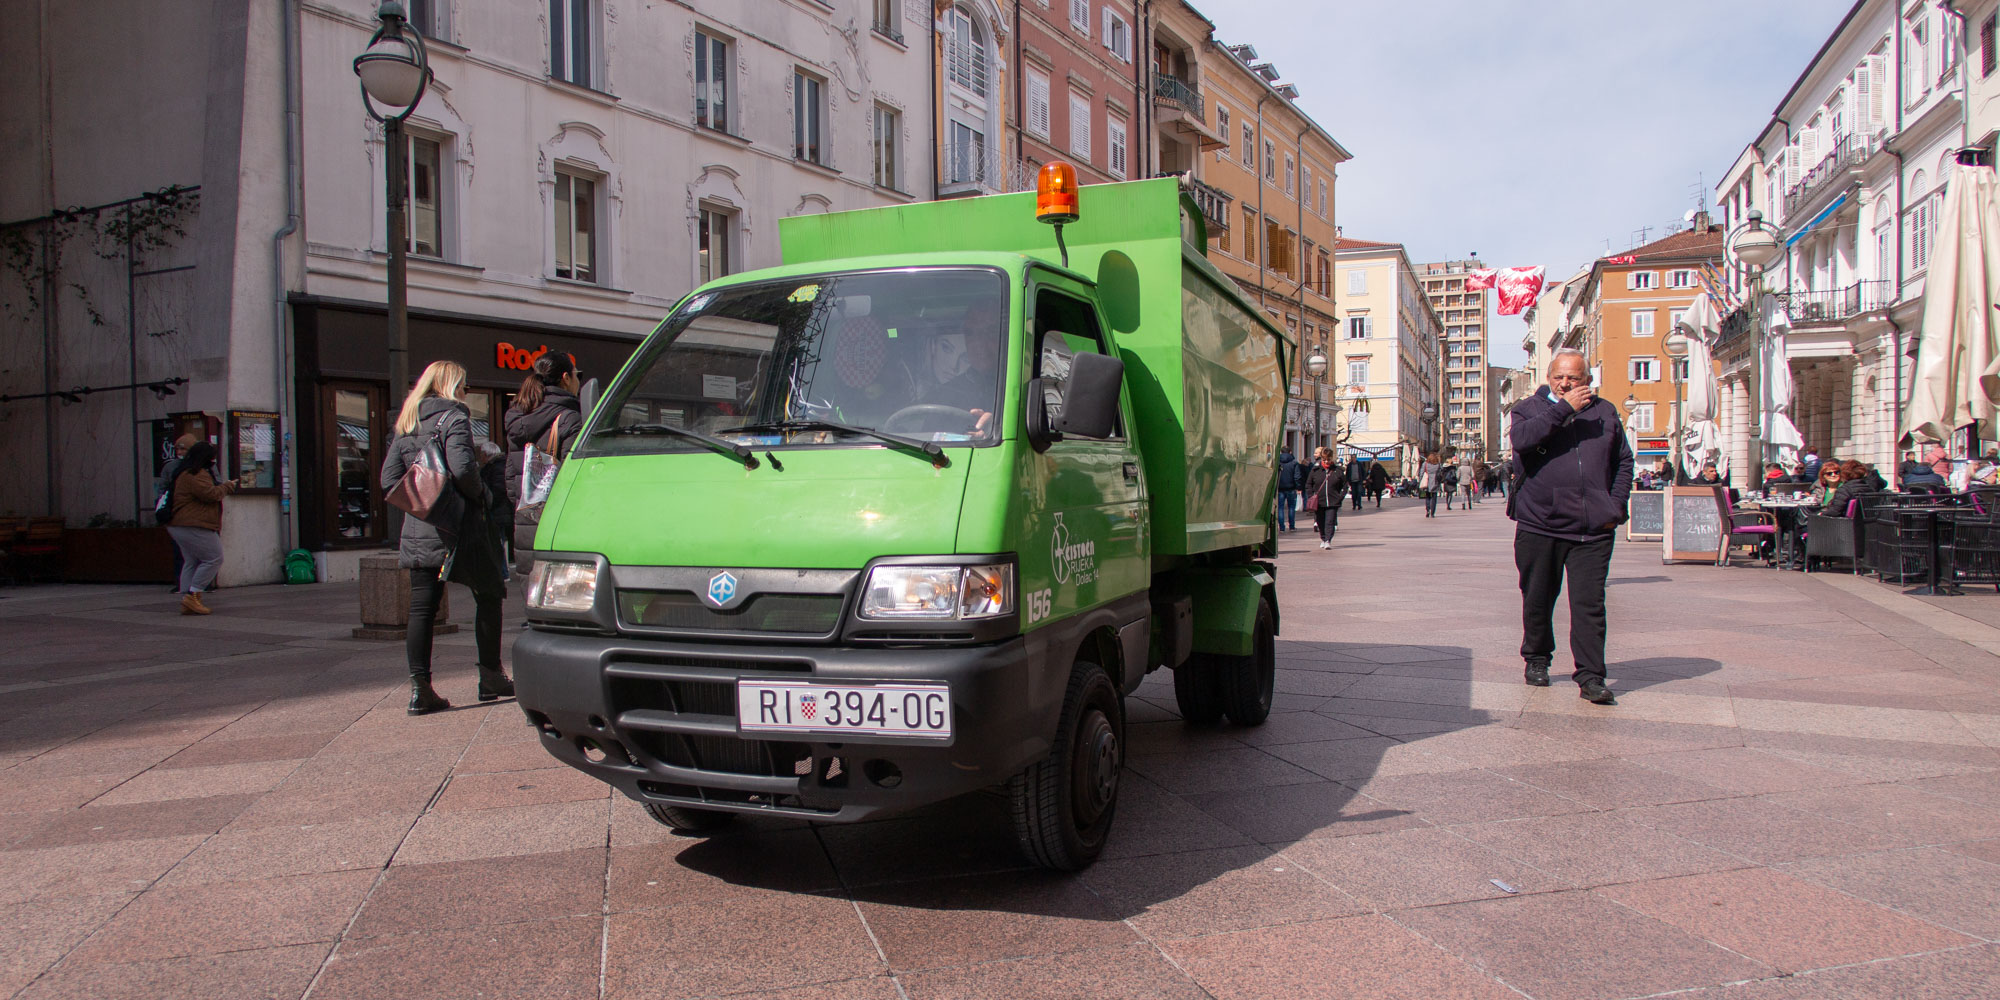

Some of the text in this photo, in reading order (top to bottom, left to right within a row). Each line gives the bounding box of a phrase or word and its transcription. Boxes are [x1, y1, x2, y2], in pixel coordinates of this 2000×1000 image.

[1070, 557, 1095, 574] RIJEKA
[1075, 567, 1100, 586] Dolac 14
[1026, 587, 1052, 624] 156
[759, 689, 945, 729] RI 394-OG
